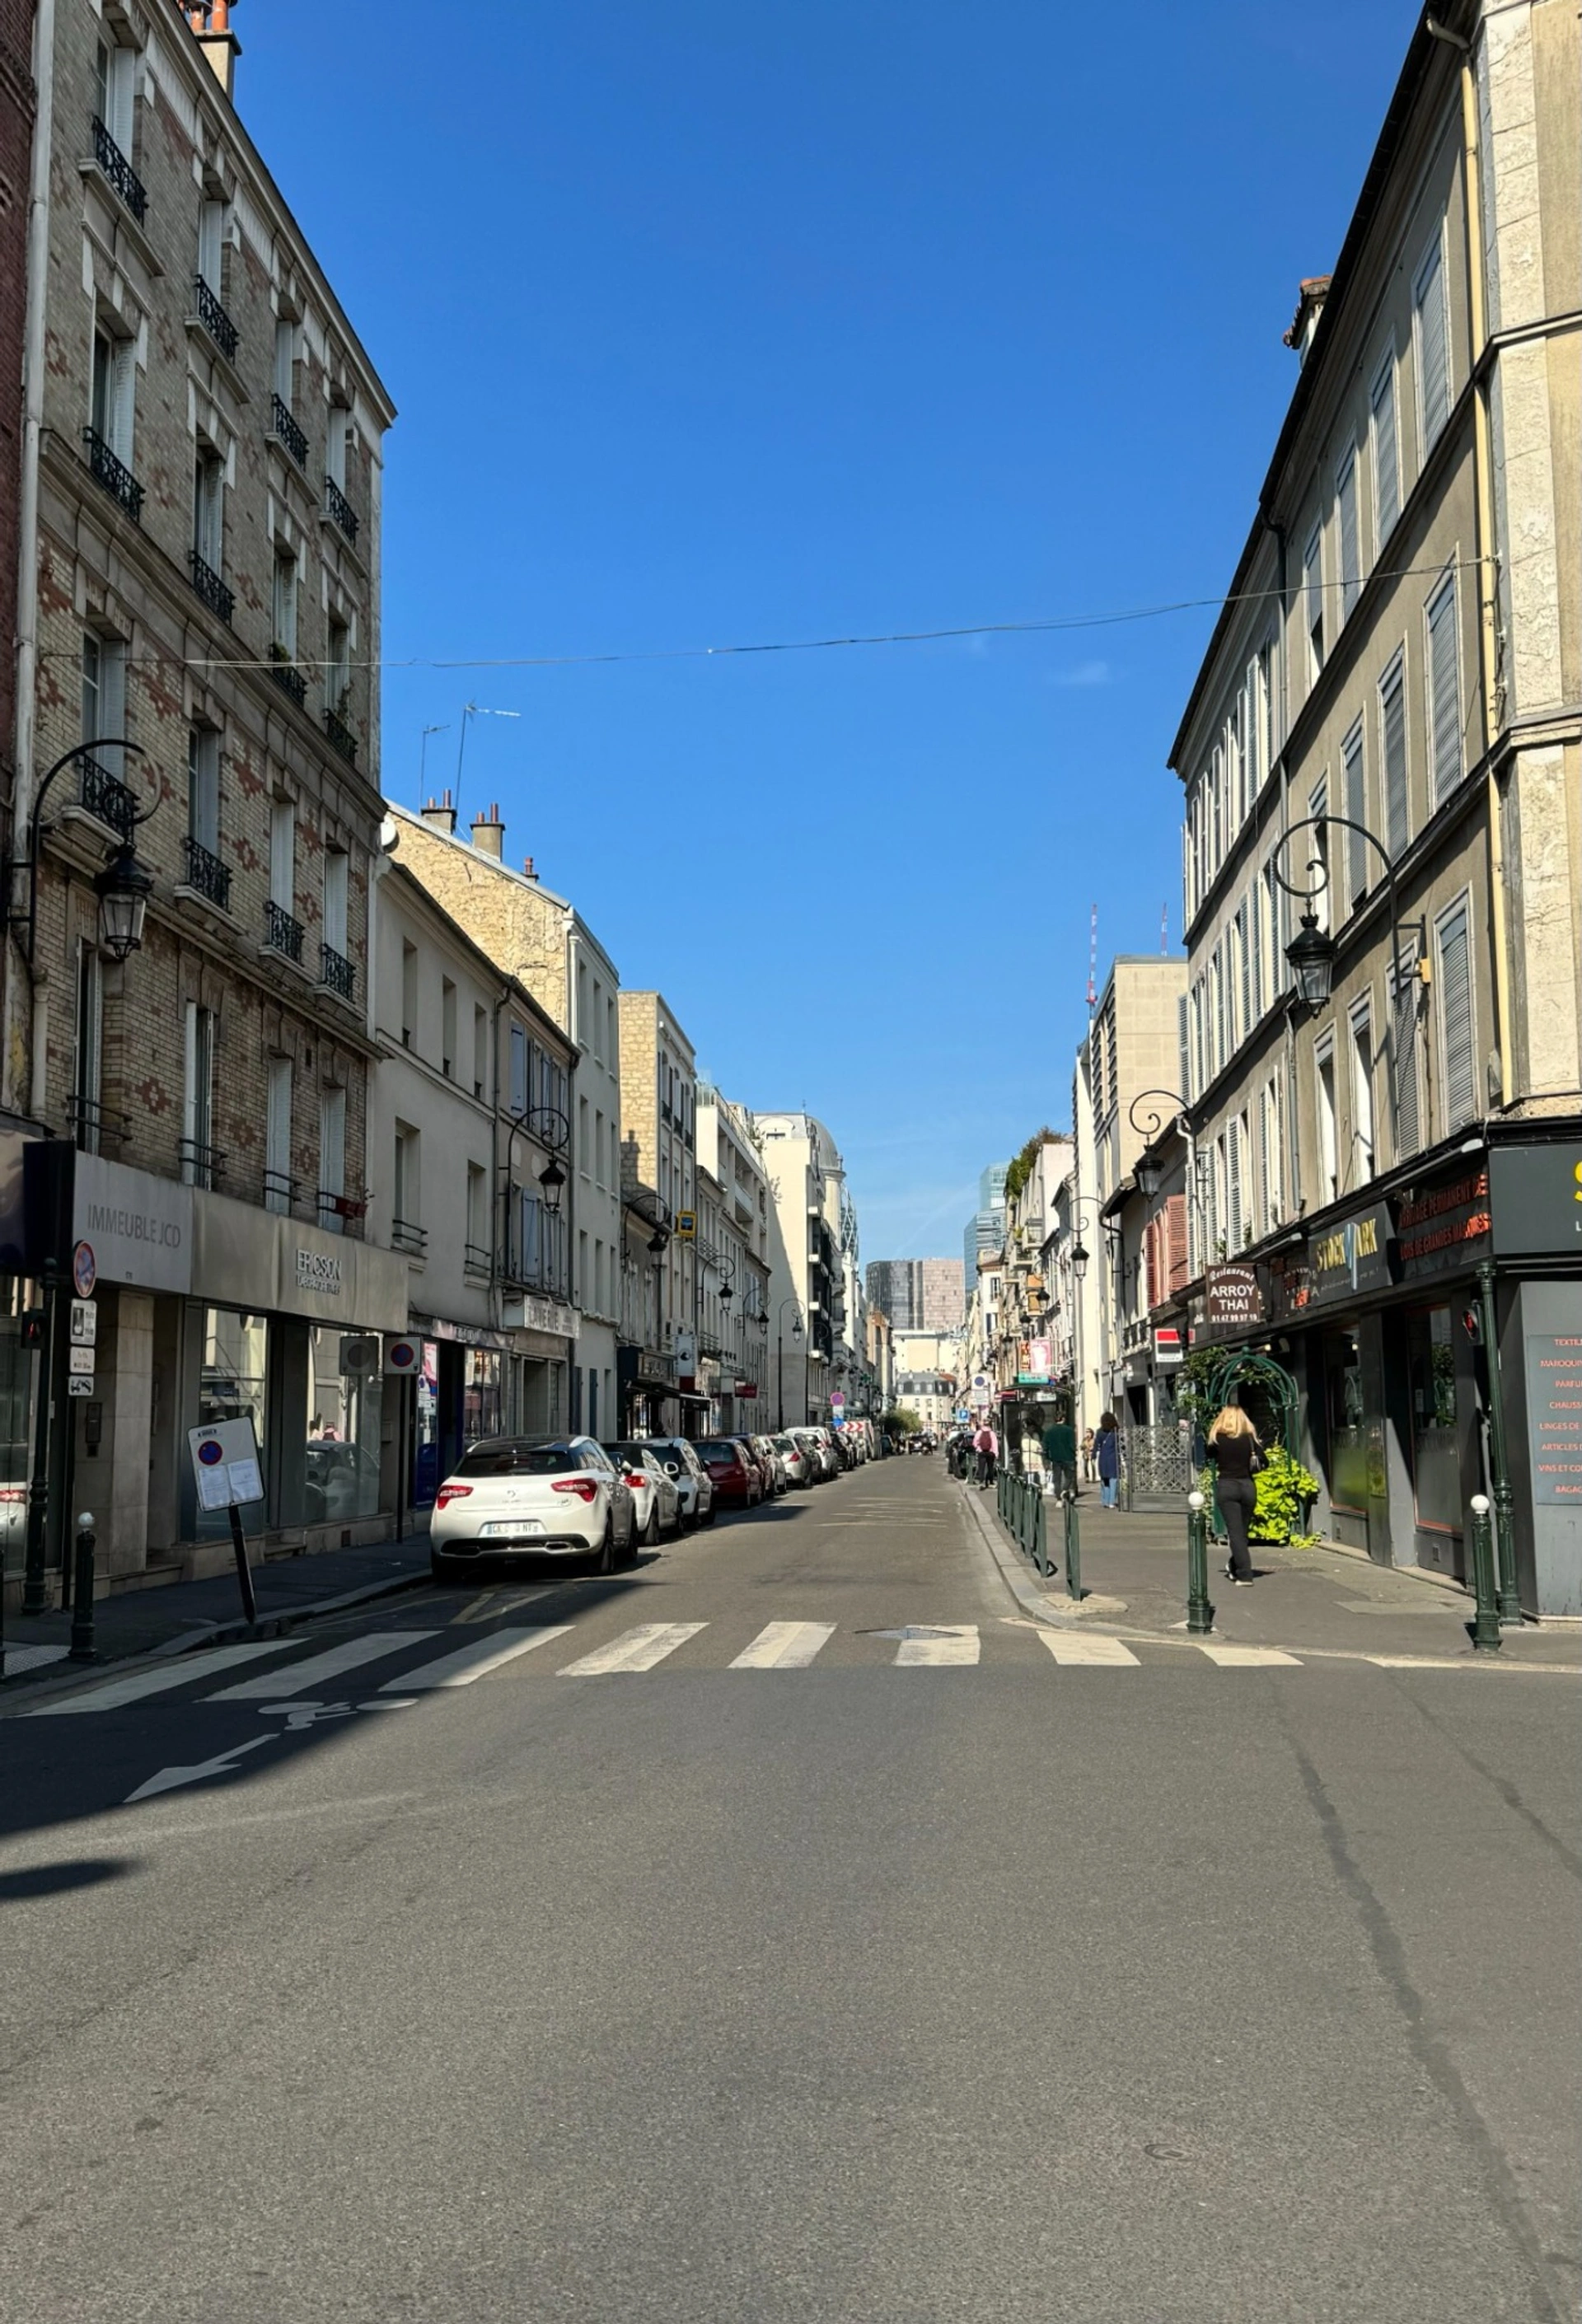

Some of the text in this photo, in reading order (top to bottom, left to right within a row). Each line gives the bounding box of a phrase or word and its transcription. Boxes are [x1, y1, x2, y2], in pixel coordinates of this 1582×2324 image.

[87, 1204, 181, 1248] IMMEUBLE JCD
[297, 1248, 342, 1280] ERICSON
[1209, 1267, 1255, 1283] Restaurant
[1210, 1284, 1256, 1298] ARROY
[1218, 1298, 1249, 1311] THAI
[1549, 1400, 1582, 1409] CHAUSS
[1539, 1422, 1580, 1430] LINGES DE
[1538, 1464, 1582, 1472] VINS ET CO
